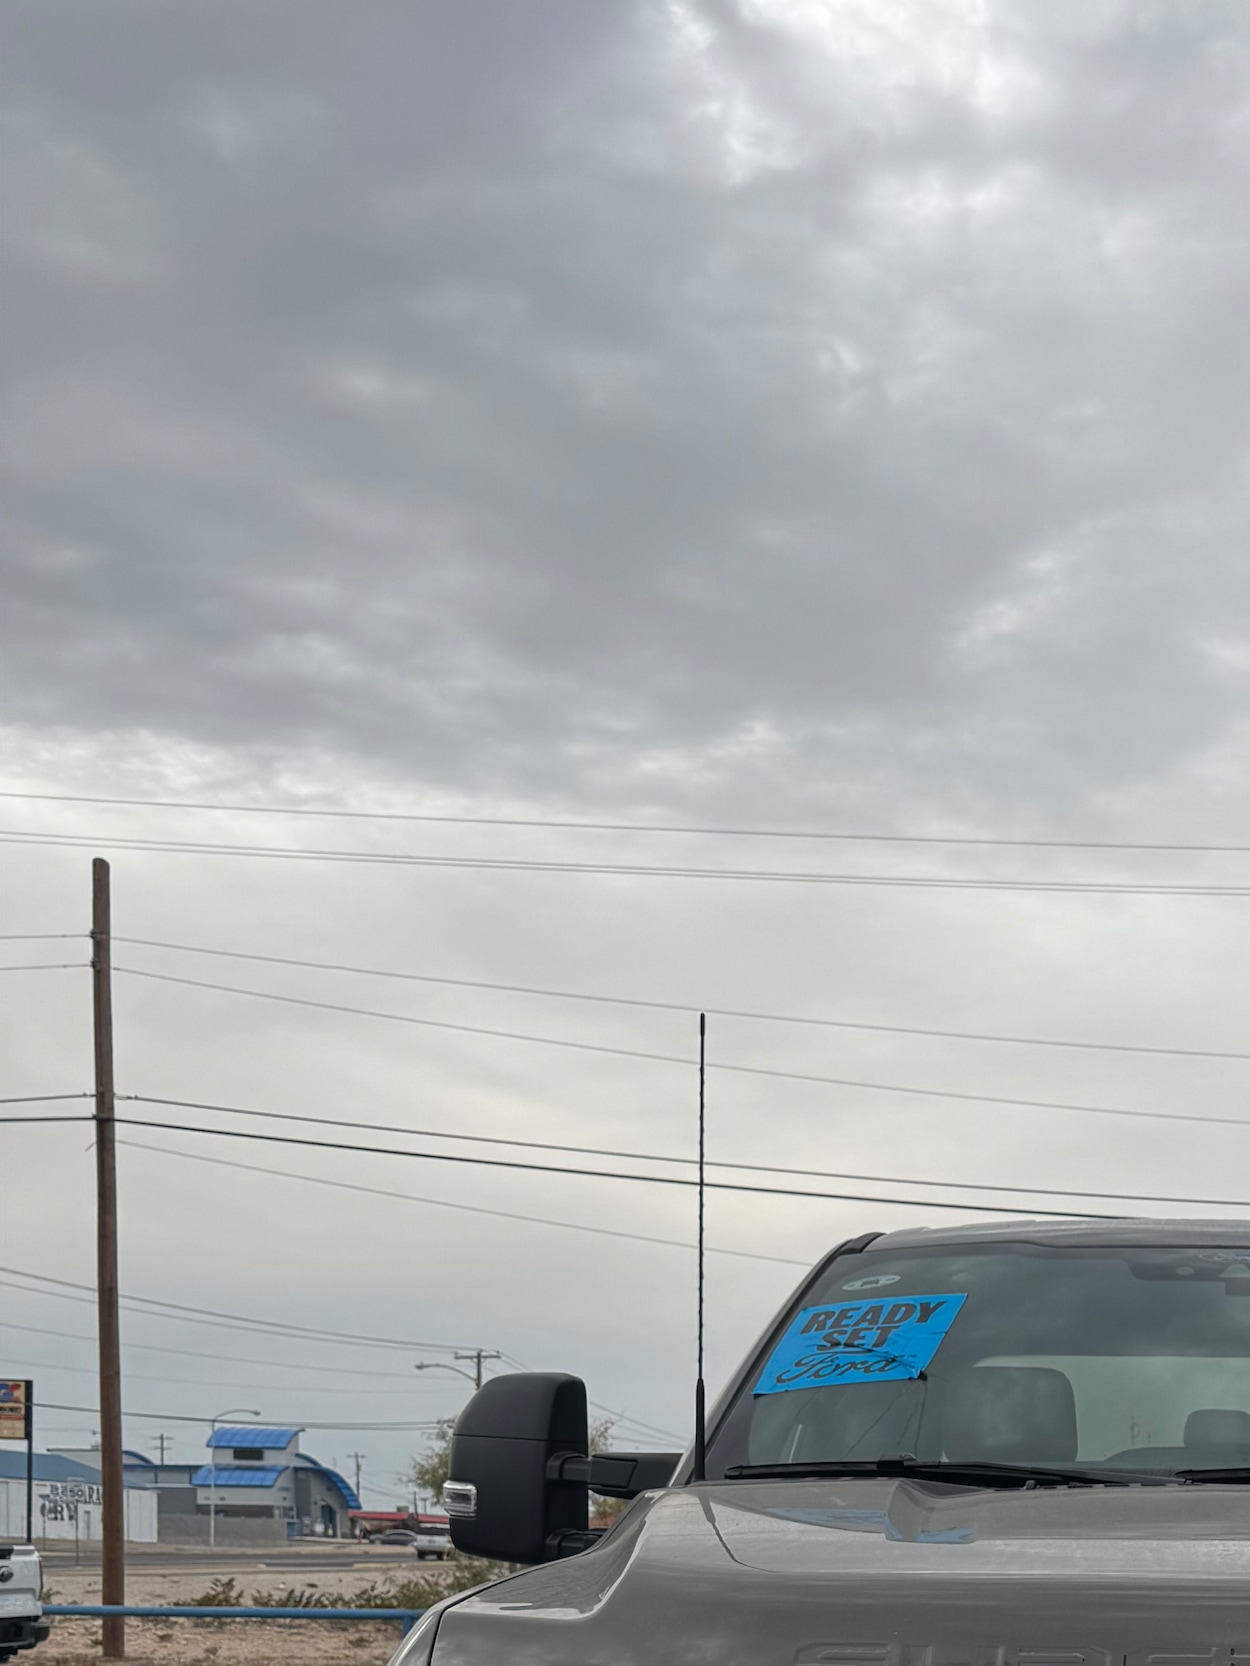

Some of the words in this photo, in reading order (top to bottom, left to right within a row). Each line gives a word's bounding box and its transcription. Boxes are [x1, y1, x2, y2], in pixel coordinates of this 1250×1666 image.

[801, 1301, 947, 1334] READY
[816, 1325, 900, 1351] SET
[775, 1350, 903, 1384] Ford
